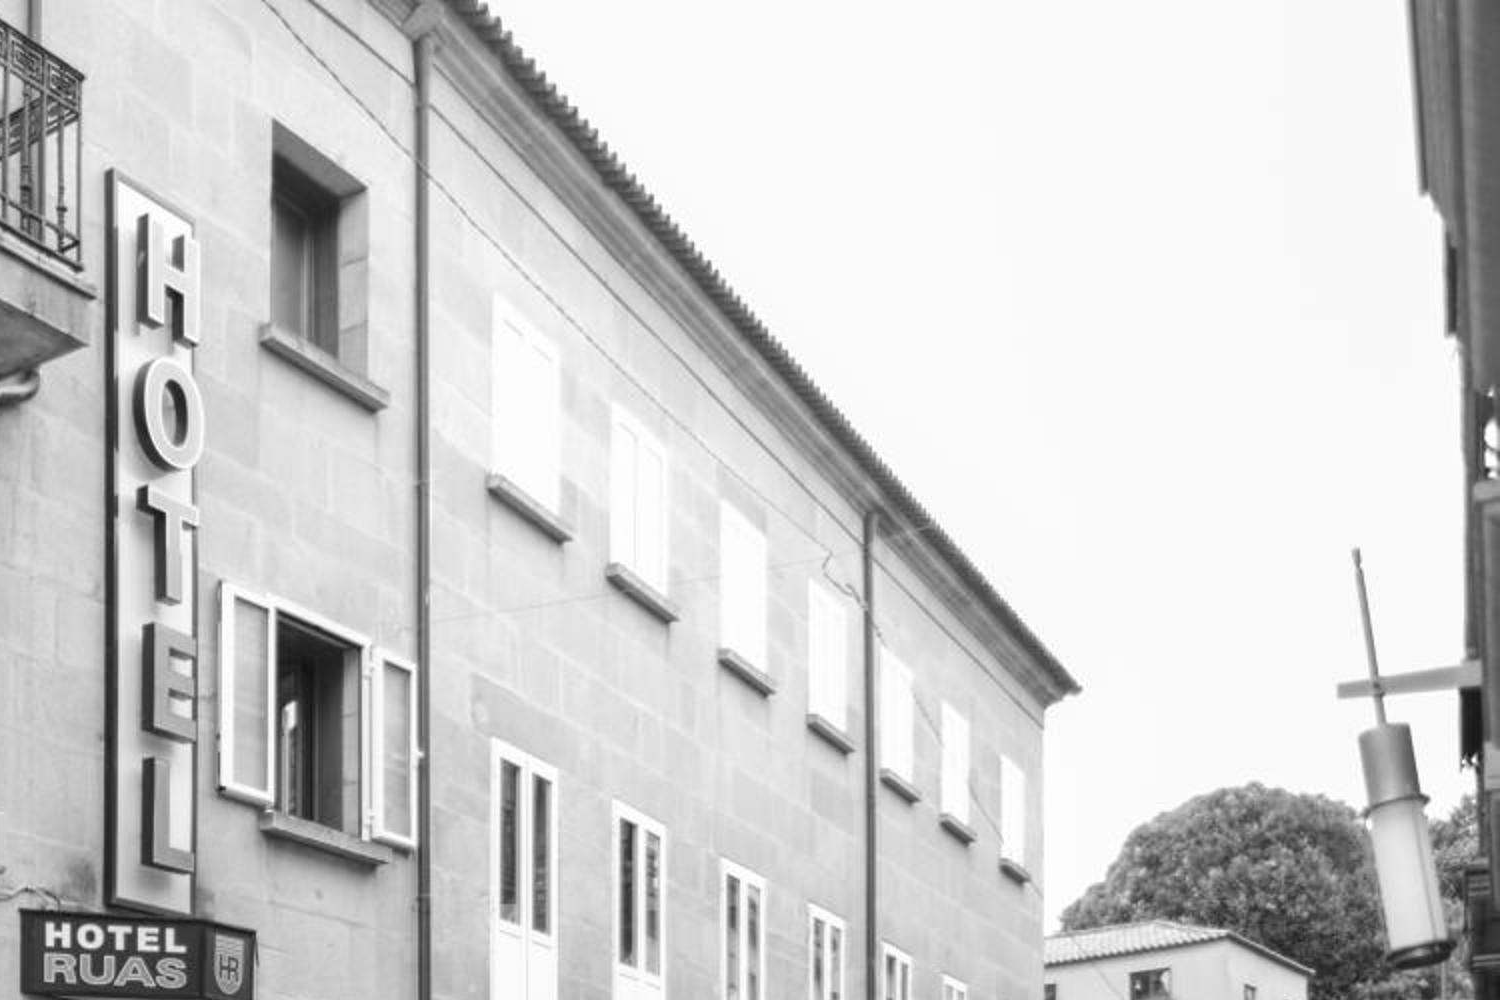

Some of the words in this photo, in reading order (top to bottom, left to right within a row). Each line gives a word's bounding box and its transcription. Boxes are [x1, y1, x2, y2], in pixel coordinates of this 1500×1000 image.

[136, 212, 204, 875] HOTEL
[44, 922, 187, 953] HOTEL
[43, 952, 188, 989] RUAS
